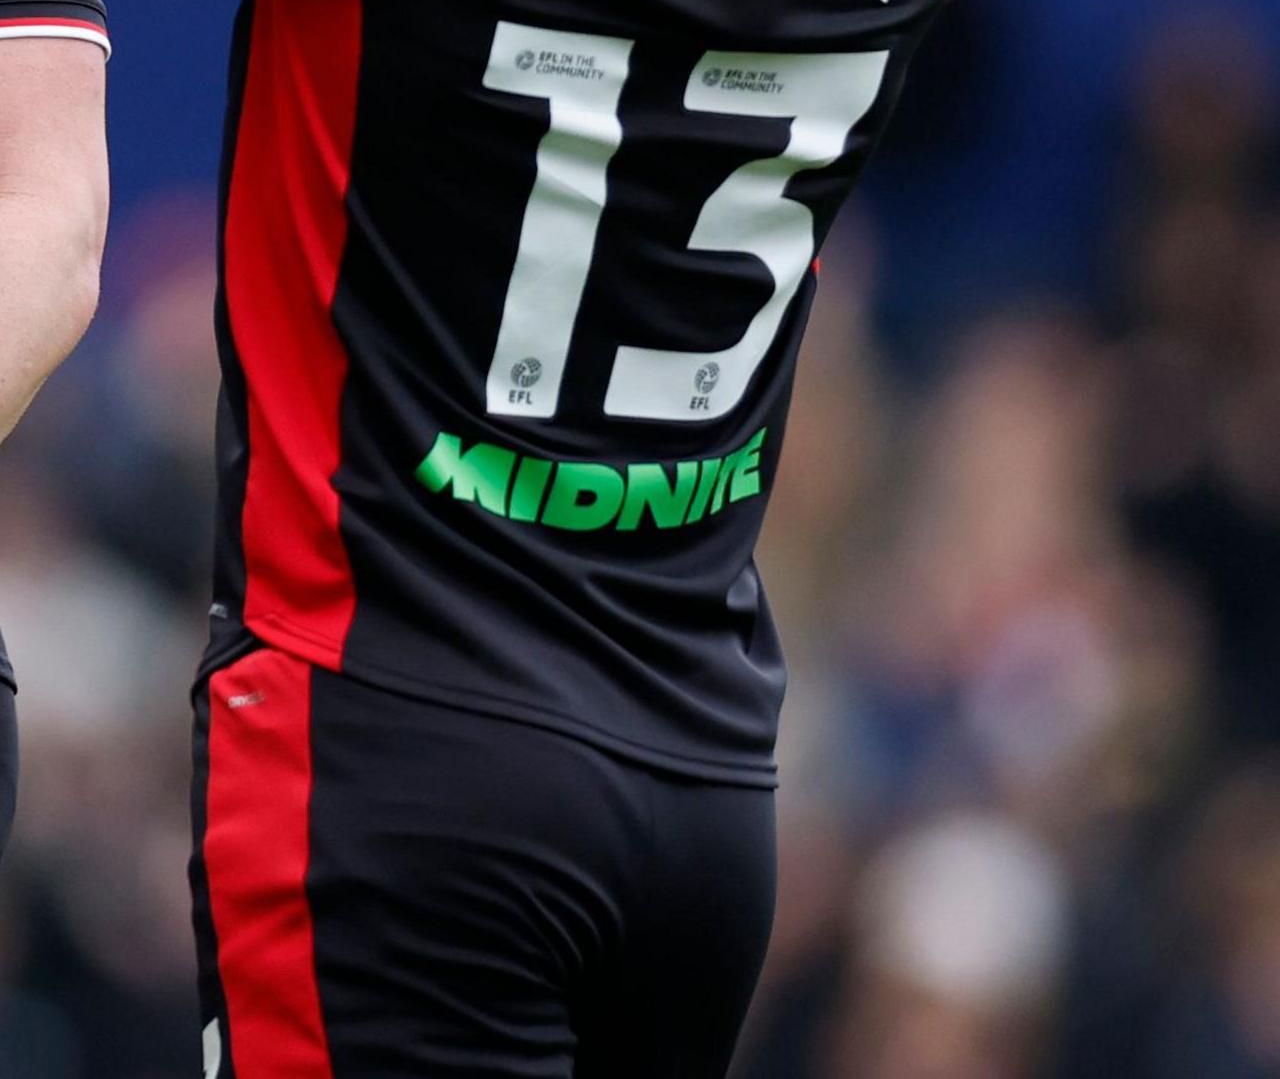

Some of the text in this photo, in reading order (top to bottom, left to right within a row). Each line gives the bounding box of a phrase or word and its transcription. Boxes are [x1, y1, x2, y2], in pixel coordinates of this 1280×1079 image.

[576, 55, 596, 67] THE
[536, 63, 605, 80] COMMUNITY
[482, 20, 890, 420] 13
[508, 389, 533, 405] EFL
[689, 396, 710, 410] EFL
[414, 427, 767, 532] MIDNITE
